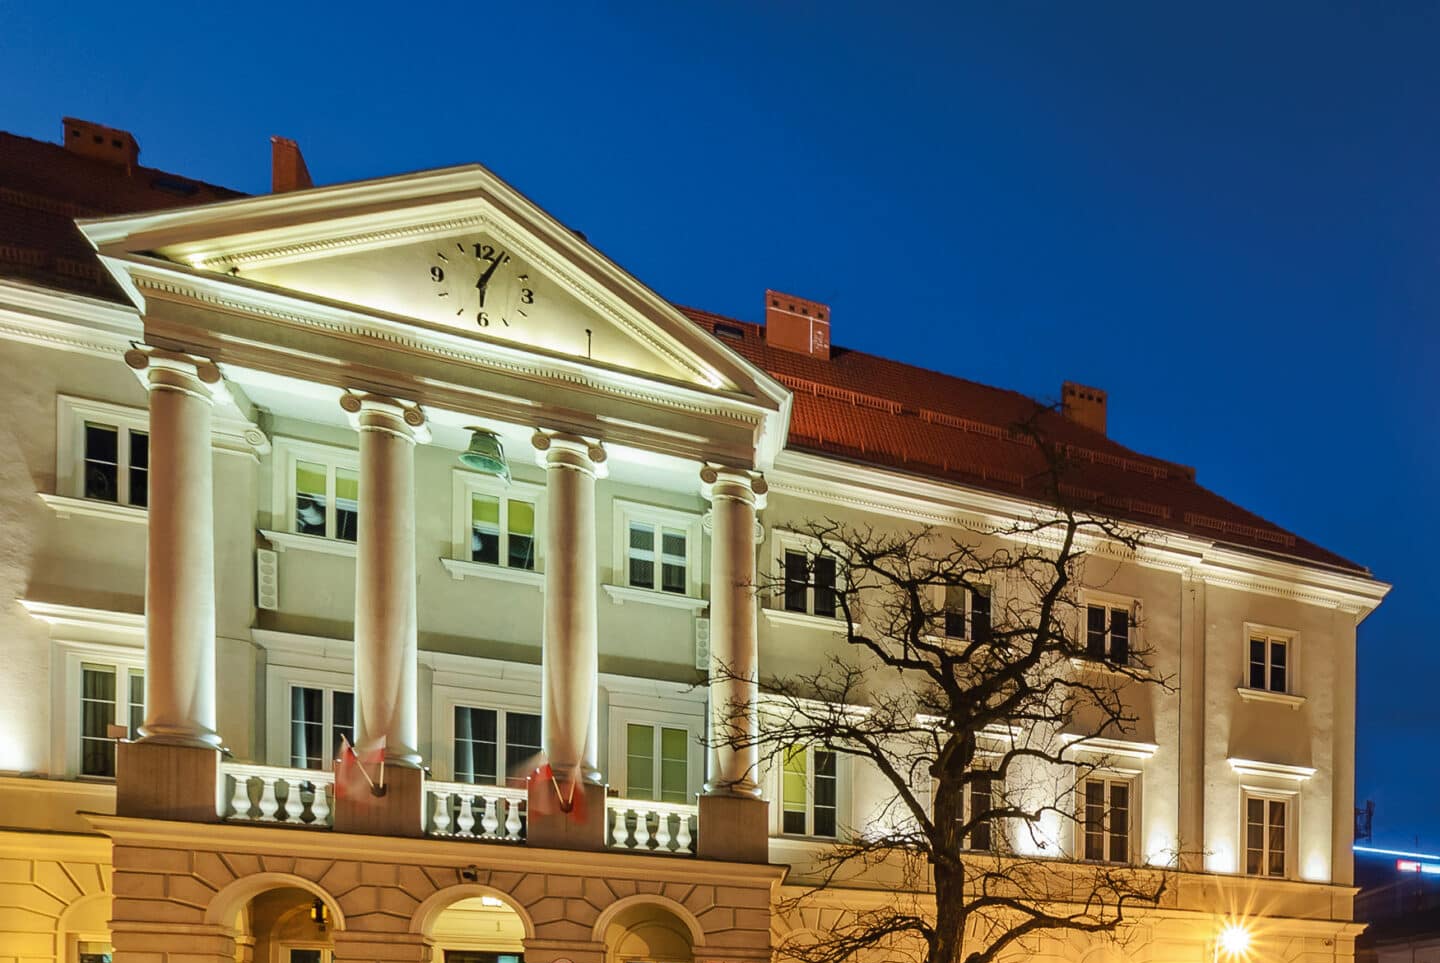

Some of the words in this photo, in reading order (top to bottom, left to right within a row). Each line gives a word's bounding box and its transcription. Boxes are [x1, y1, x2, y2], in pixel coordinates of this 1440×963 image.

[472, 243, 496, 262] 12
[430, 266, 445, 282] 9
[521, 288, 534, 304] 3
[477, 312, 489, 327] 6
